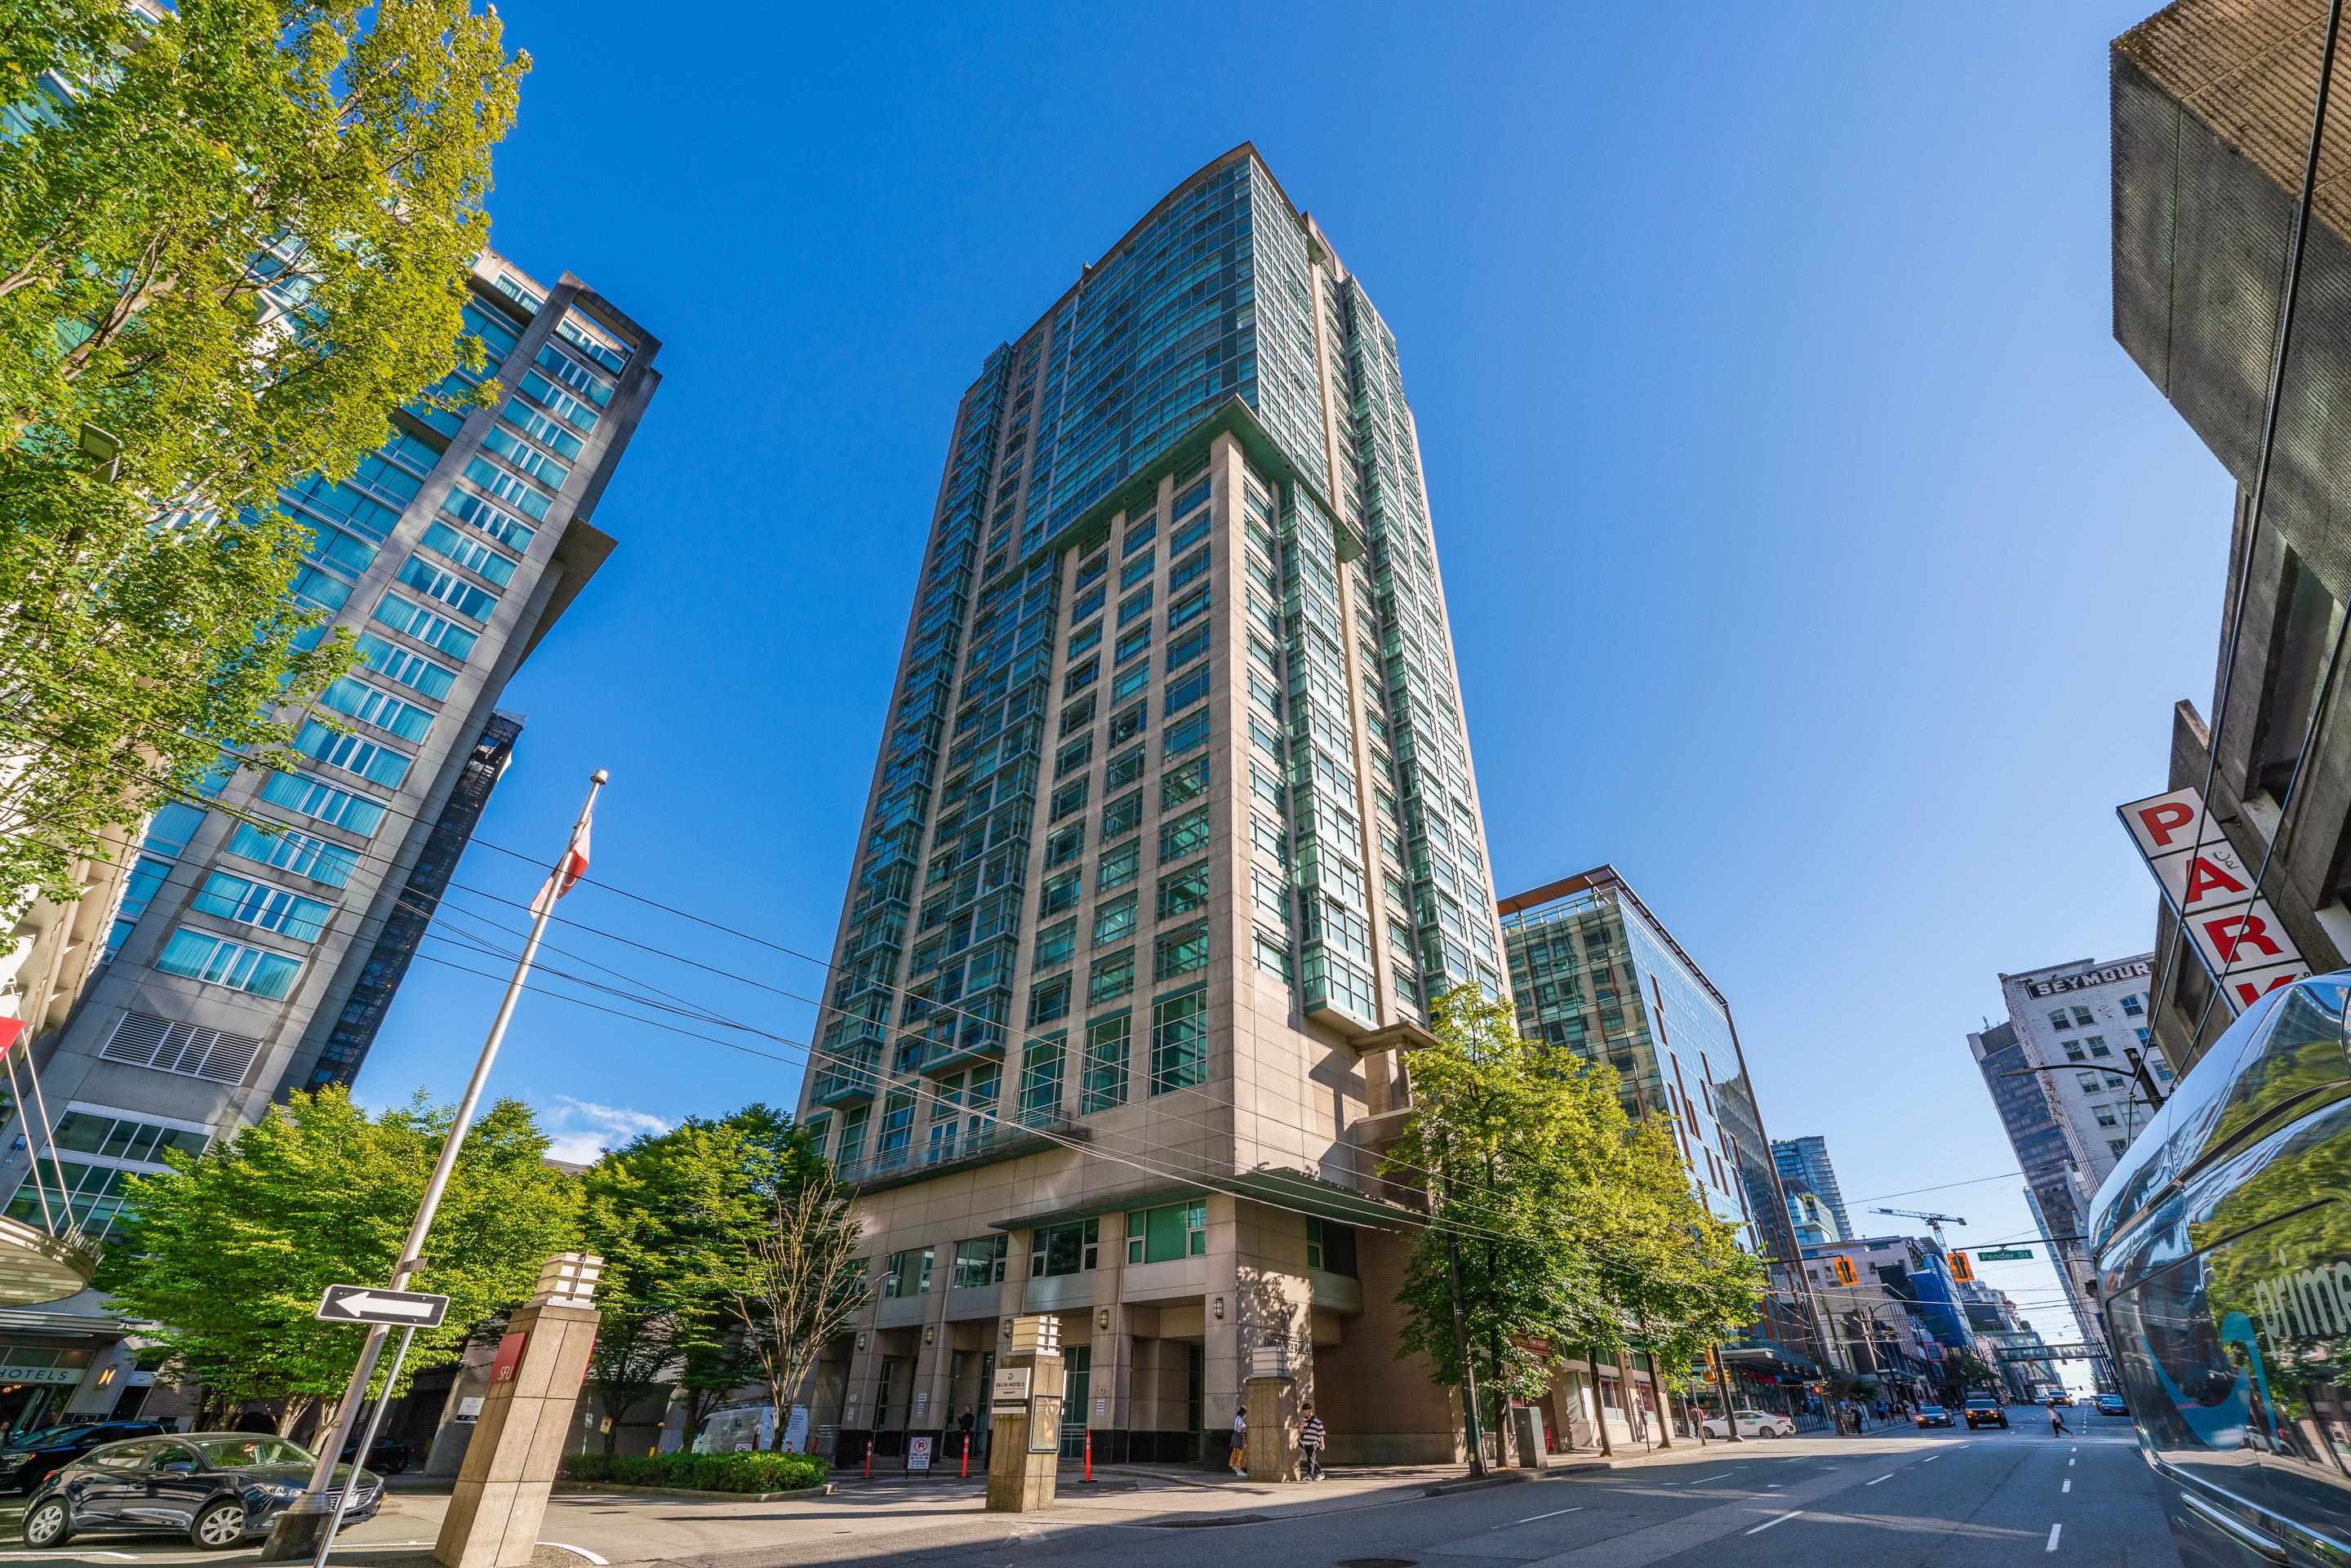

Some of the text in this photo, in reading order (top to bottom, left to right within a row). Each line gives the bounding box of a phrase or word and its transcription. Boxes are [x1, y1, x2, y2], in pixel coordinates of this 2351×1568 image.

[2037, 962, 2151, 995] SEYMOUR
[1981, 1252, 2015, 1260] Pender
[2253, 1249, 2351, 1361] prime
[498, 1365, 514, 1380] SFU
